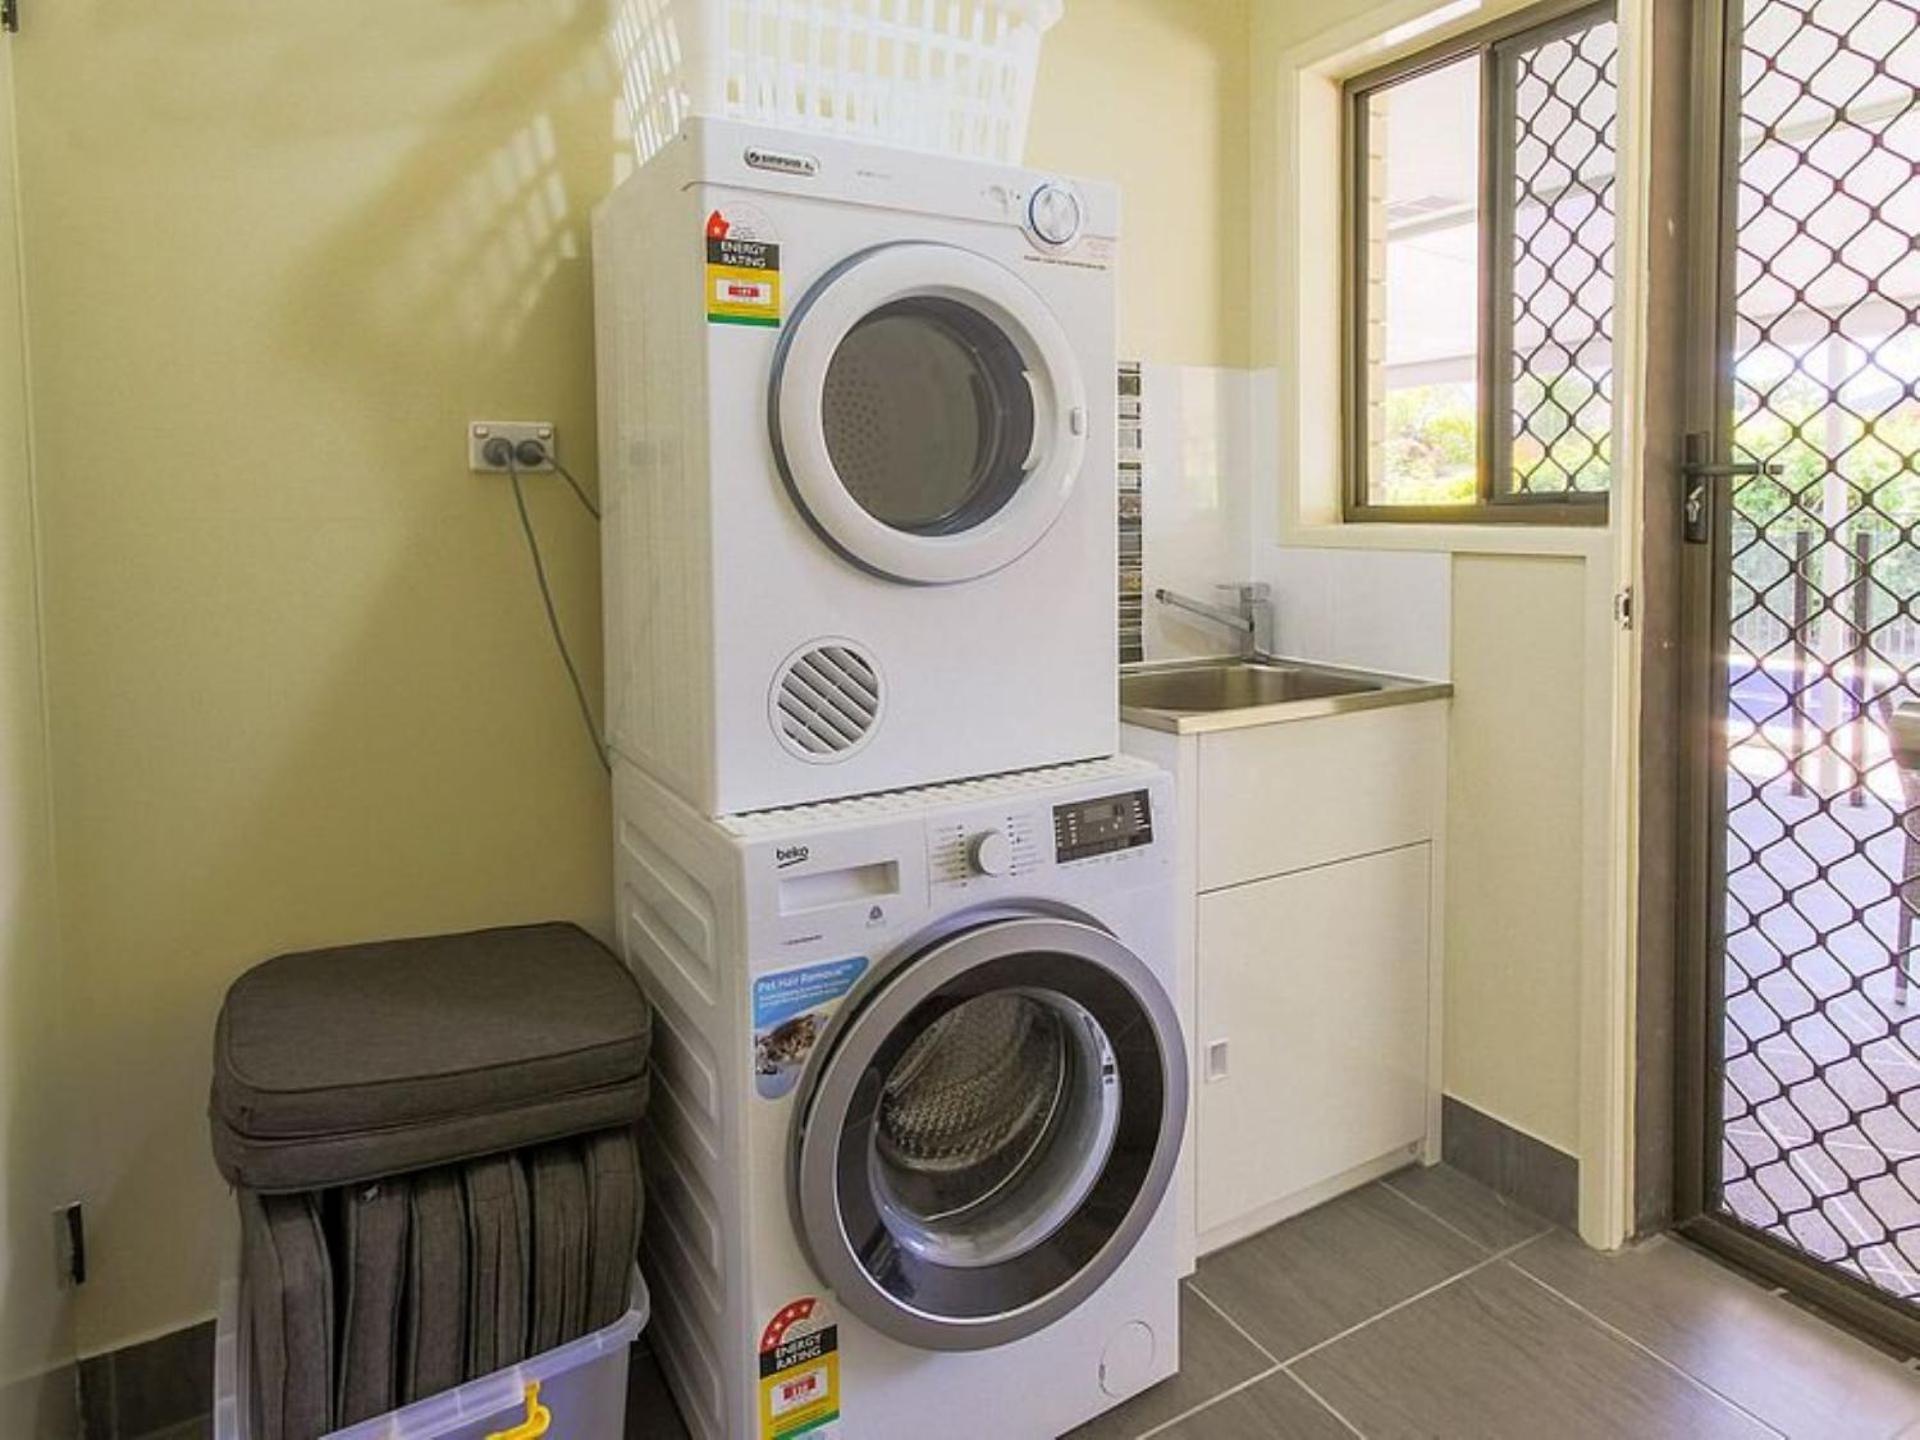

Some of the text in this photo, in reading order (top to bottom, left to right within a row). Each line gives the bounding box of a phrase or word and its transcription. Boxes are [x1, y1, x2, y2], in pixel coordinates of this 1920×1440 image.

[721, 240, 766, 255] ENERGY
[722, 253, 766, 268] RATING
[776, 846, 809, 861] beko
[758, 981, 776, 992] Pet
[779, 975, 800, 988] Hair
[775, 1334, 821, 1358] ENERGY
[777, 1346, 822, 1370] RATING
